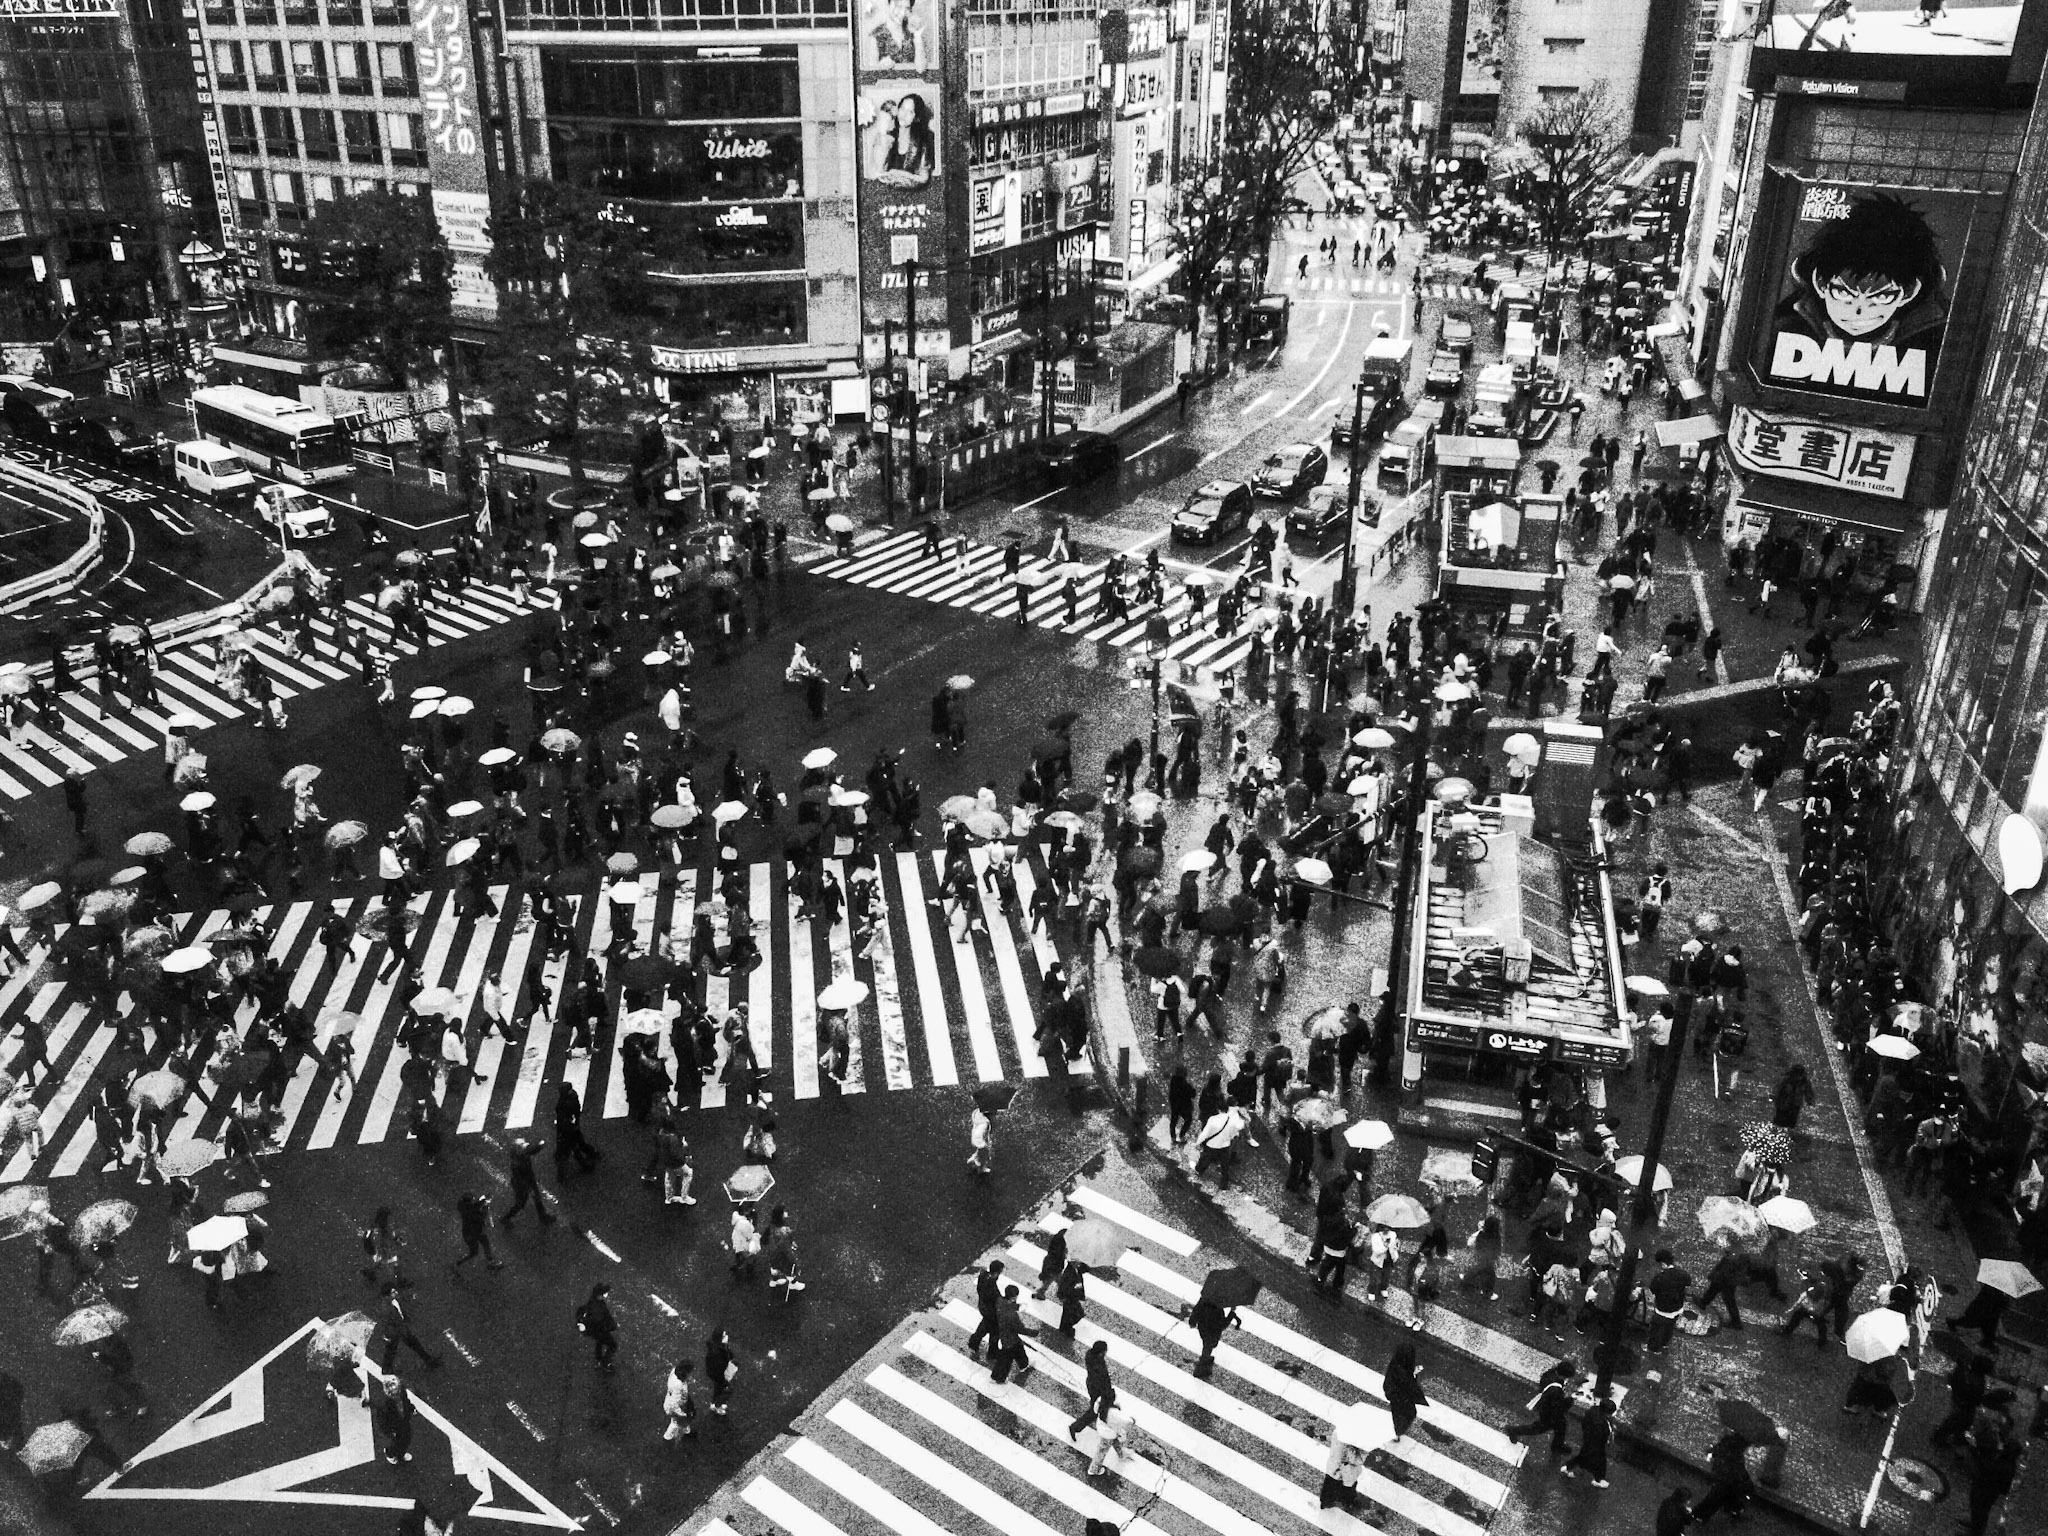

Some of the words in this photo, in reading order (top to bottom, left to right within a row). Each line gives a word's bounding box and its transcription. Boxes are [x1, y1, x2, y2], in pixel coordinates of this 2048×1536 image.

[1833, 82, 1859, 94] Vision
[454, 231, 475, 241] Store
[1057, 232, 1090, 267] LUSH
[1770, 331, 1927, 398] DMM
